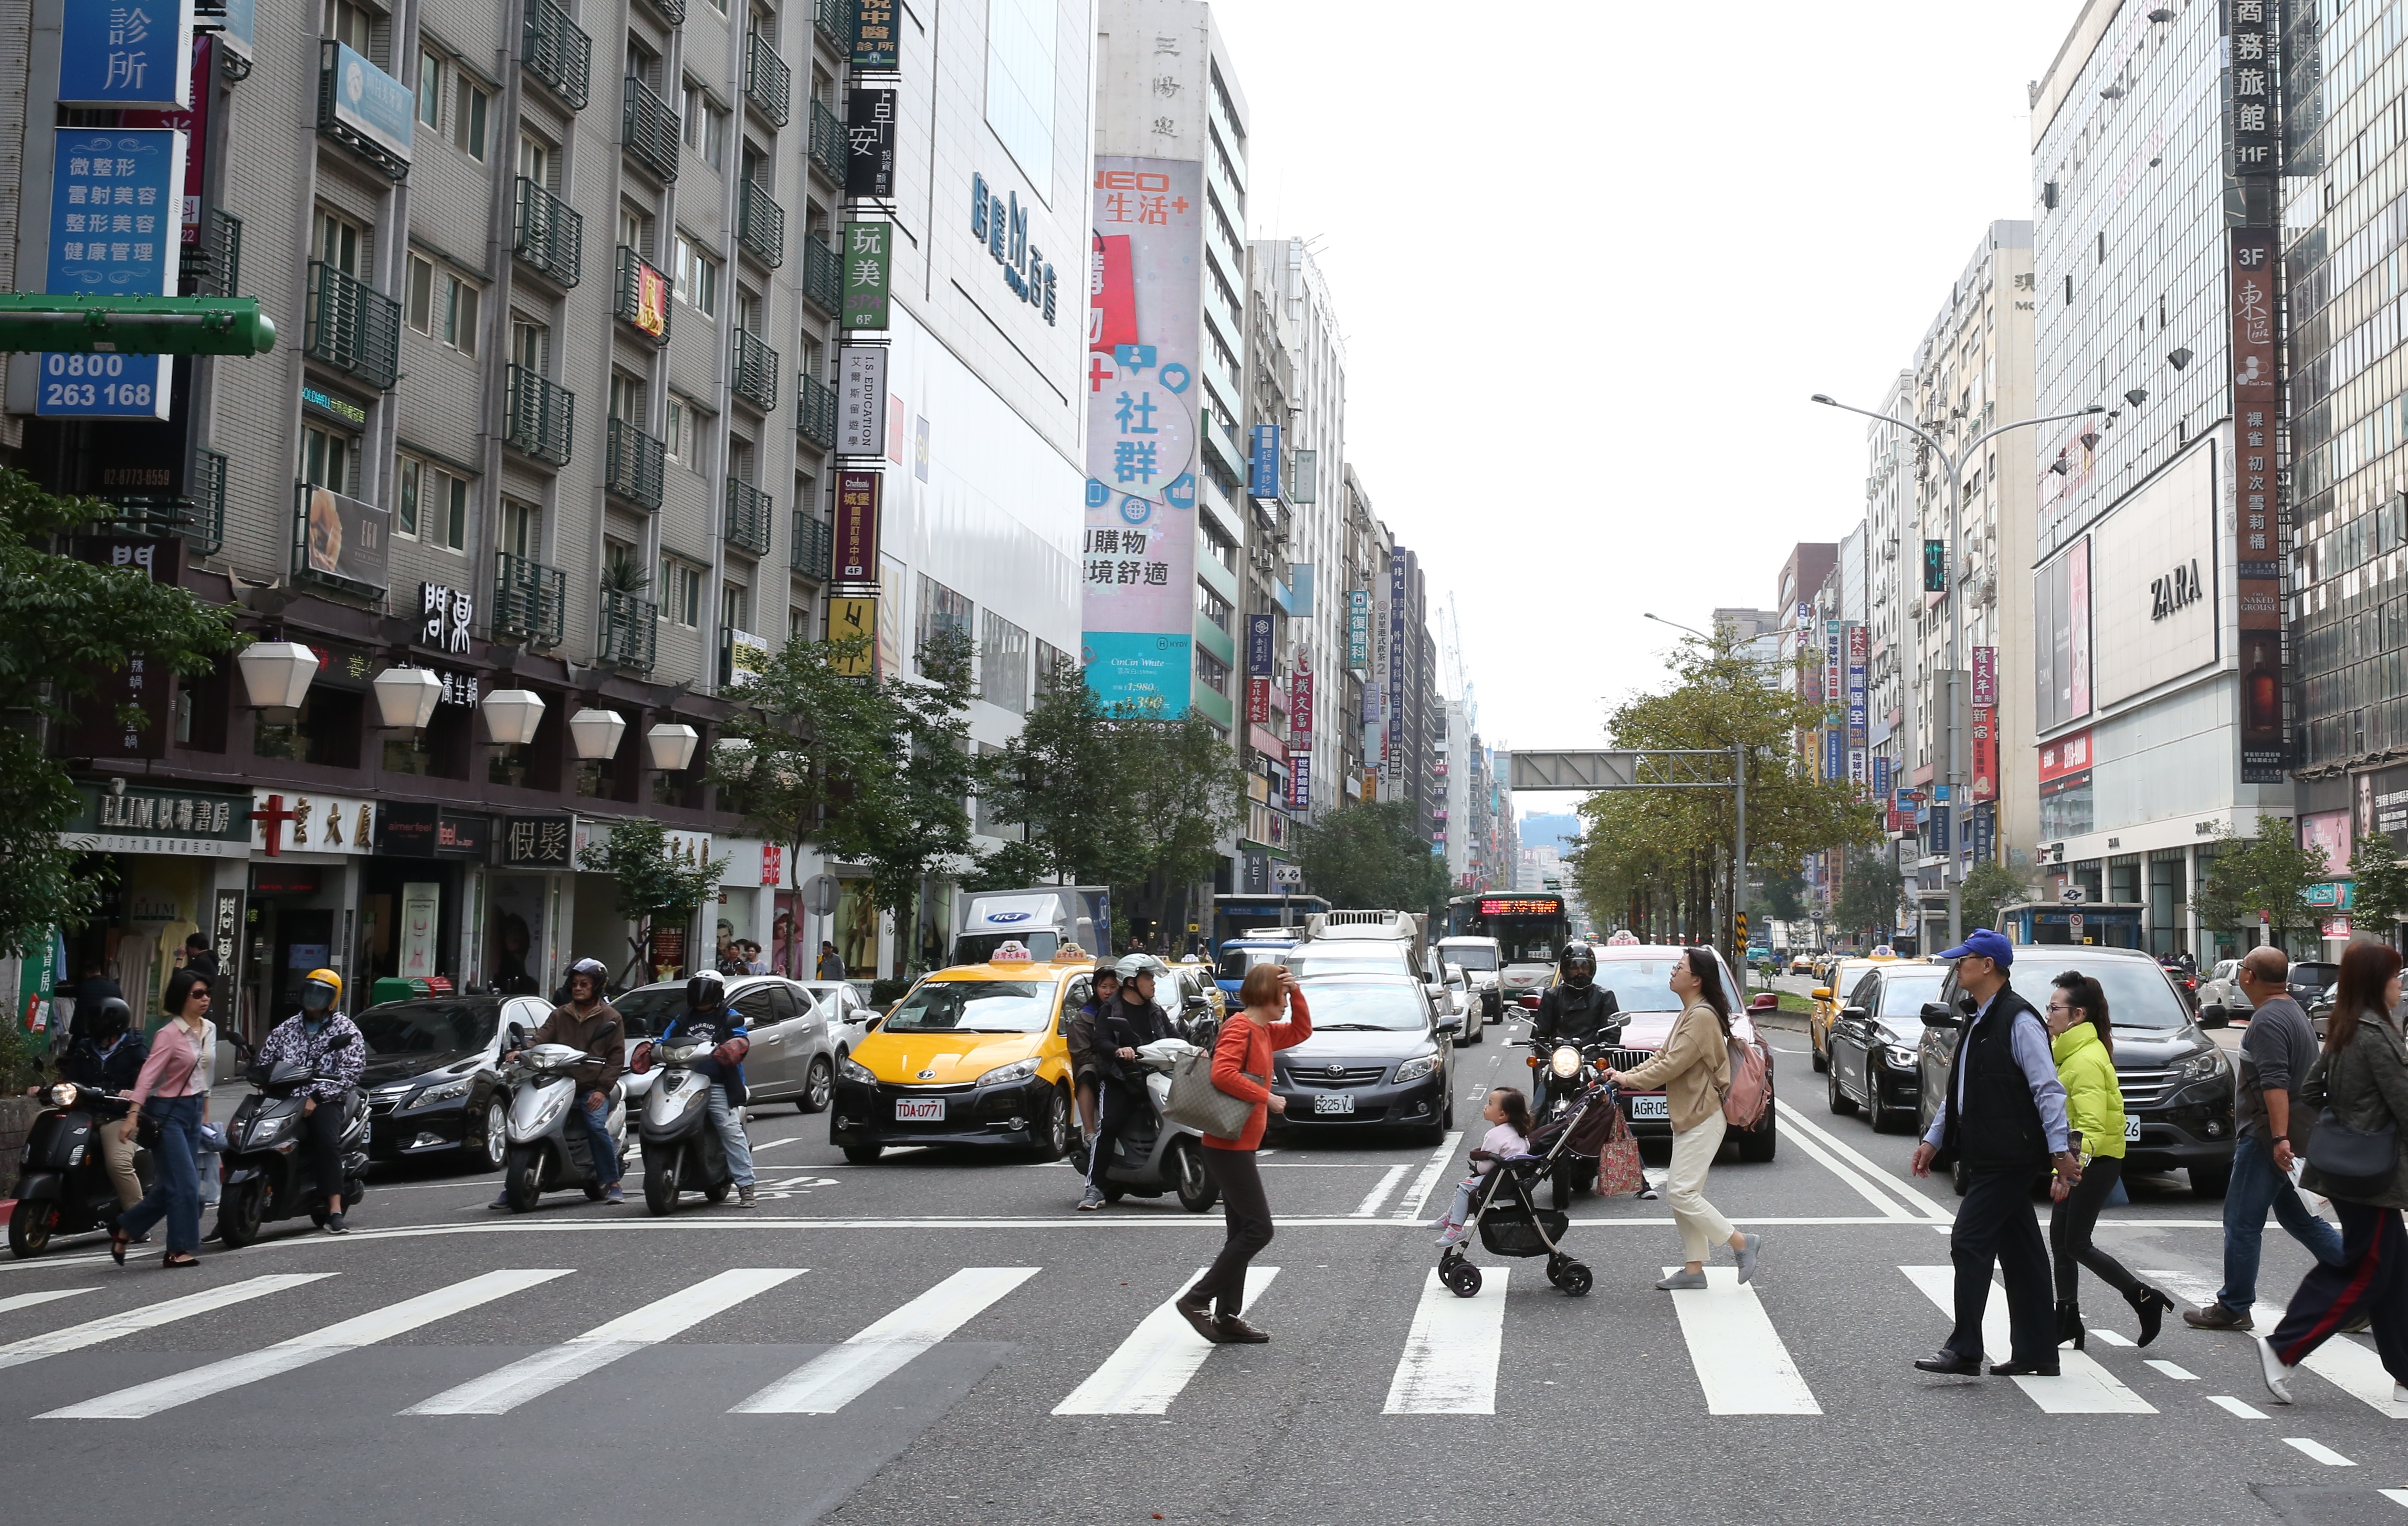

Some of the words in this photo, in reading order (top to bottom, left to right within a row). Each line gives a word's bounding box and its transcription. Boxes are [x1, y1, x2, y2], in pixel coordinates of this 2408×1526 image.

[102, 7, 150, 90] 診所
[856, 41, 895, 52] 診所
[2237, 0, 2266, 132] 商務旅館
[69, 158, 136, 177] 微整形
[2239, 147, 2268, 163] 11F
[876, 150, 892, 194] 投資顧問
[68, 185, 157, 206] 雷射美容
[65, 214, 155, 234] 整形美容
[64, 242, 154, 262] 健康管理
[851, 226, 882, 288] 玩美
[2239, 248, 2264, 266] 3F
[846, 294, 884, 310] SPA
[2235, 280, 2270, 344] 東區
[856, 315, 872, 325] 6F
[49, 355, 123, 377] 0800
[47, 384, 96, 406] 263
[103, 383, 151, 405] 168
[848, 356, 862, 446] 艾爾斯留遊學
[862, 378, 874, 447] EDUCATION
[1114, 390, 1158, 485] 社群
[2246, 412, 2264, 447] 裸雀
[916, 433, 928, 465] GU
[104, 469, 170, 486] 02-8773-6559
[843, 493, 870, 506] 城堡
[2247, 455, 2266, 550] 初次雪莉桶
[849, 506, 862, 566] 國際訂房中心
[1082, 560, 1170, 586] 境舒適
[1393, 567, 1404, 590] 非凡
[2150, 558, 2203, 621] ZARA
[1351, 615, 1365, 659] 復健科
[1111, 658, 1139, 666] CinCin
[1141, 659, 1165, 667] White
[1975, 647, 1991, 695] 霍天年
[1850, 664, 1864, 725] 德保全
[1973, 709, 1988, 740] 新宿
[1852, 752, 1863, 779] 地球村
[1976, 741, 1985, 774] 髮型團隊
[1974, 776, 1992, 796] 4
[98, 794, 155, 829] ELIM
[388, 822, 433, 832] aimerfeel
[508, 821, 567, 861] 假髮
[2108, 837, 2120, 849] ZARA
[1252, 856, 1260, 886] NET
[897, 1104, 942, 1117] TDA-0771
[1315, 1099, 1354, 1111] 6225-VJ
[1634, 1102, 1669, 1115] AGR-05
[2124, 1122, 2139, 1136] 26
